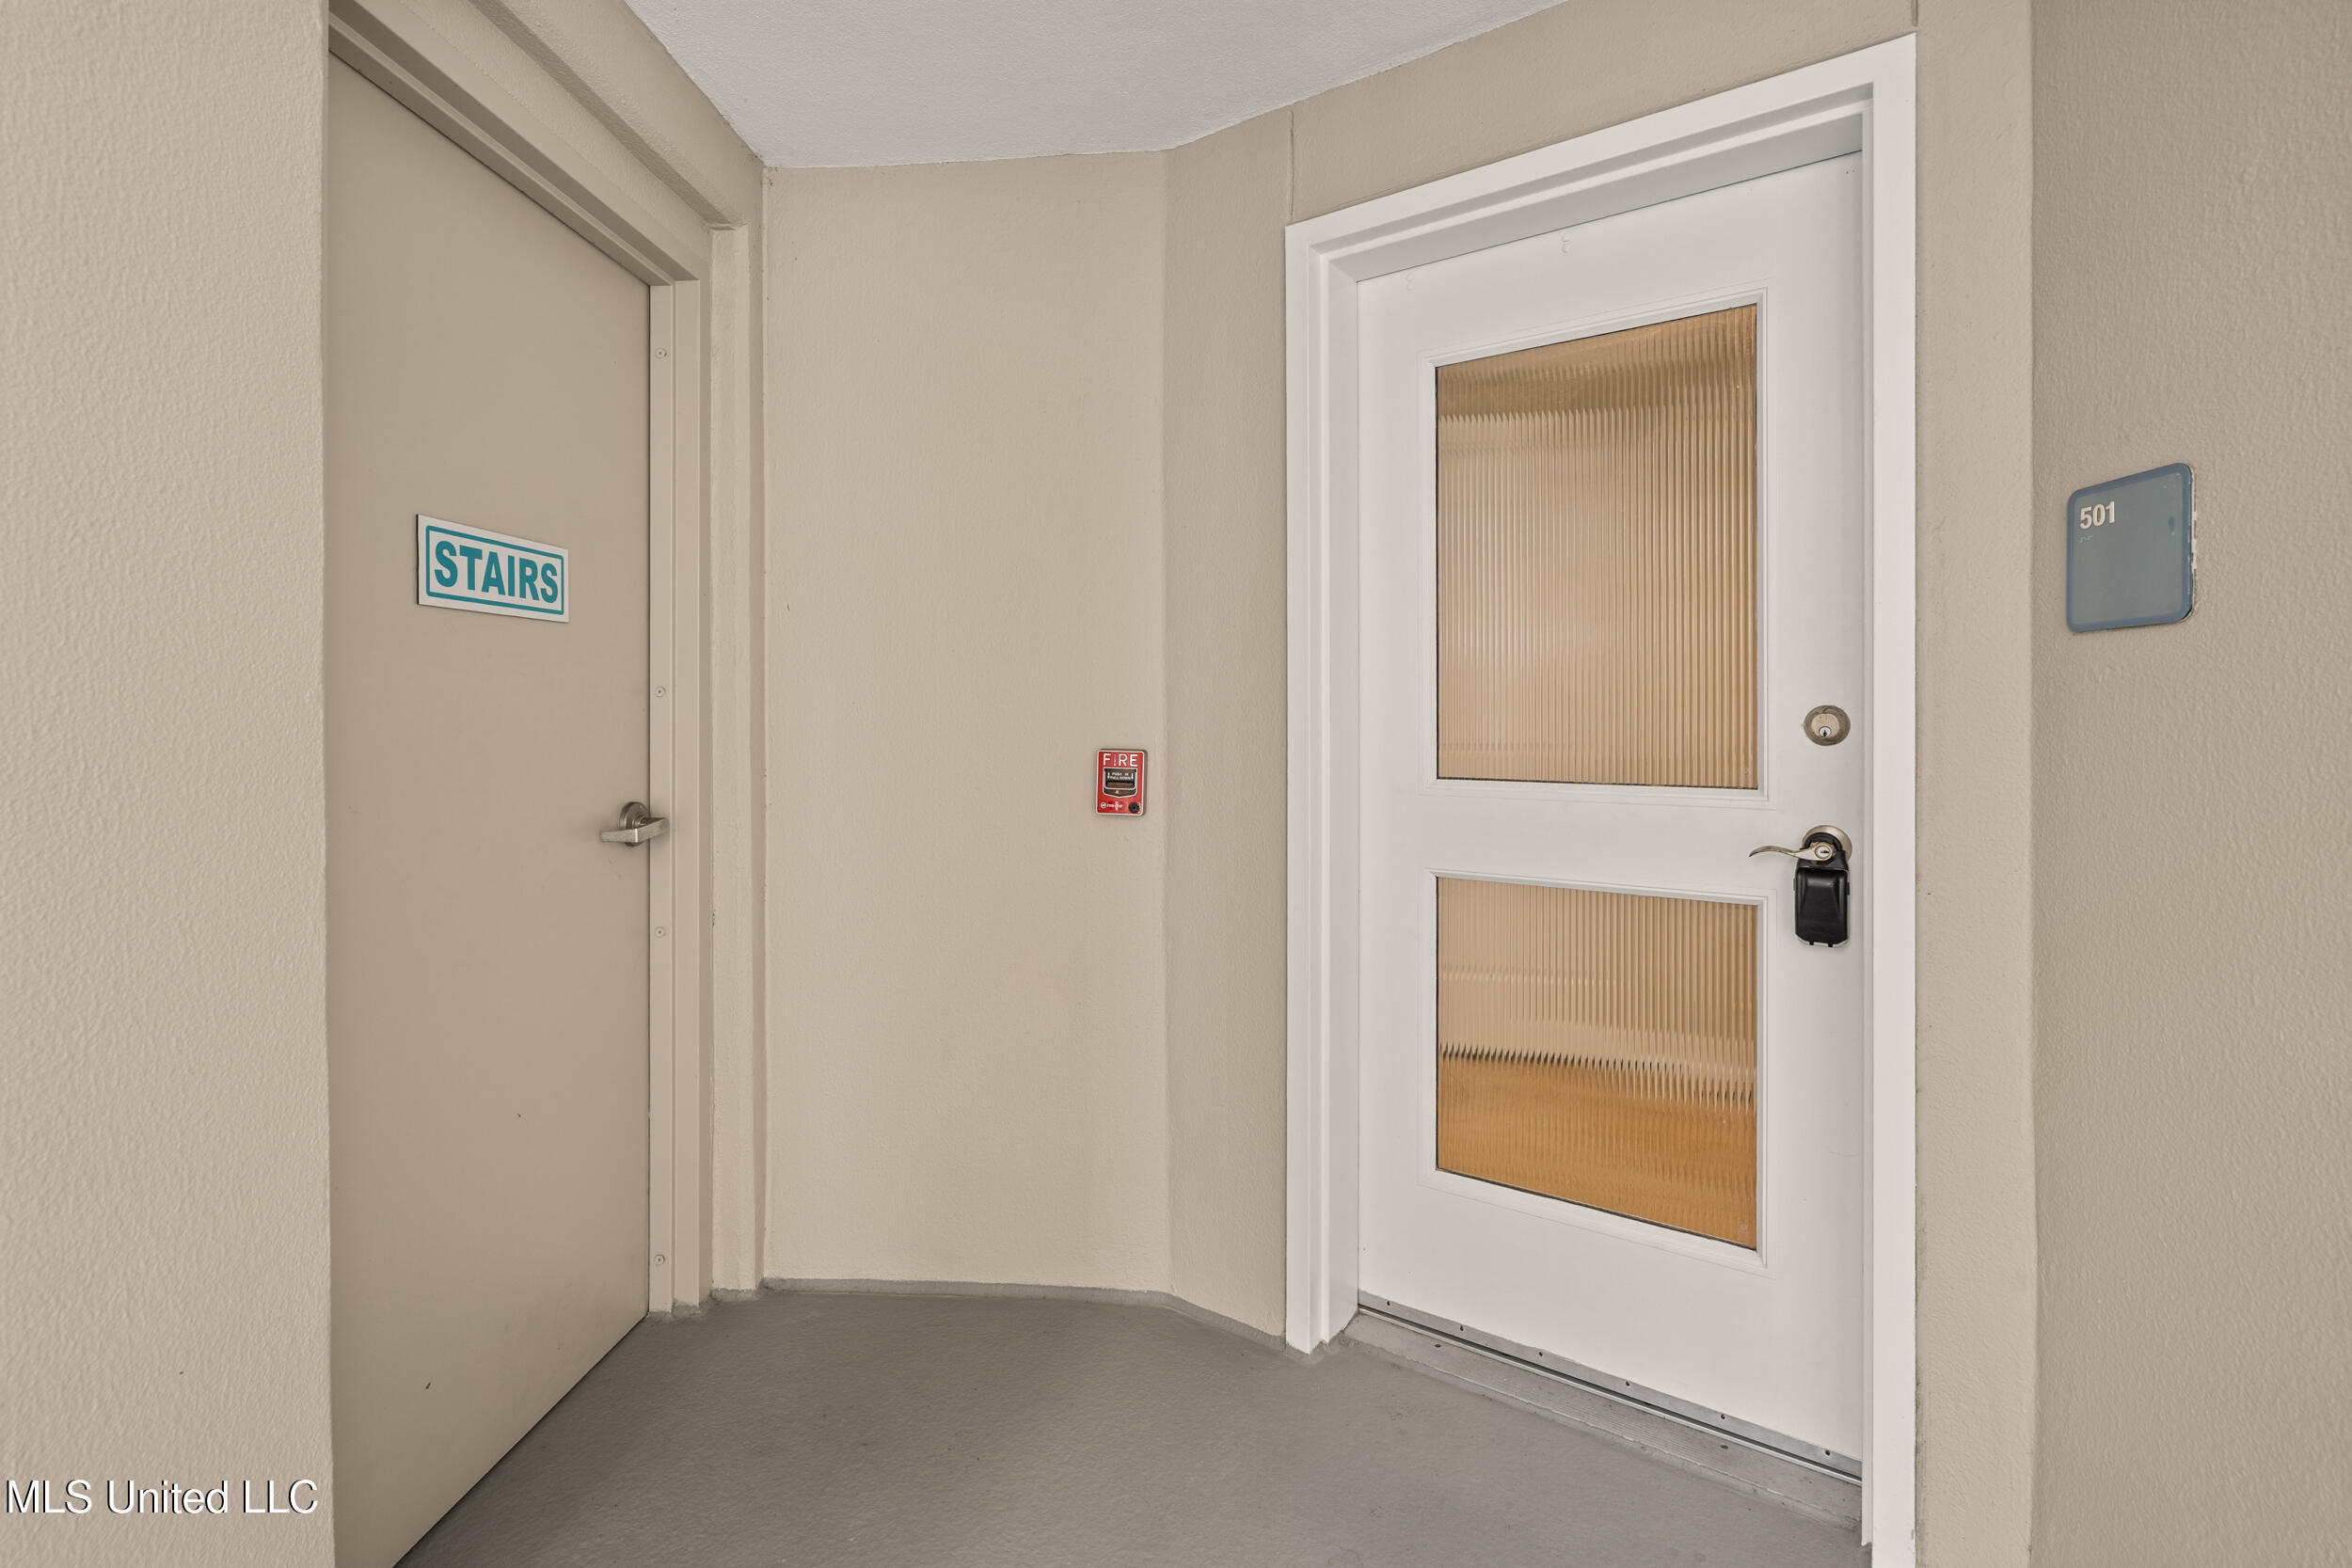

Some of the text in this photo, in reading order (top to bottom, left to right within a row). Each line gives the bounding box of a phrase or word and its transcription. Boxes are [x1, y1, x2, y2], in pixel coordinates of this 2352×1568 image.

[2079, 500, 2116, 530] 501
[434, 540, 559, 604] STAIRS
[1103, 752, 1138, 767] FIRE
